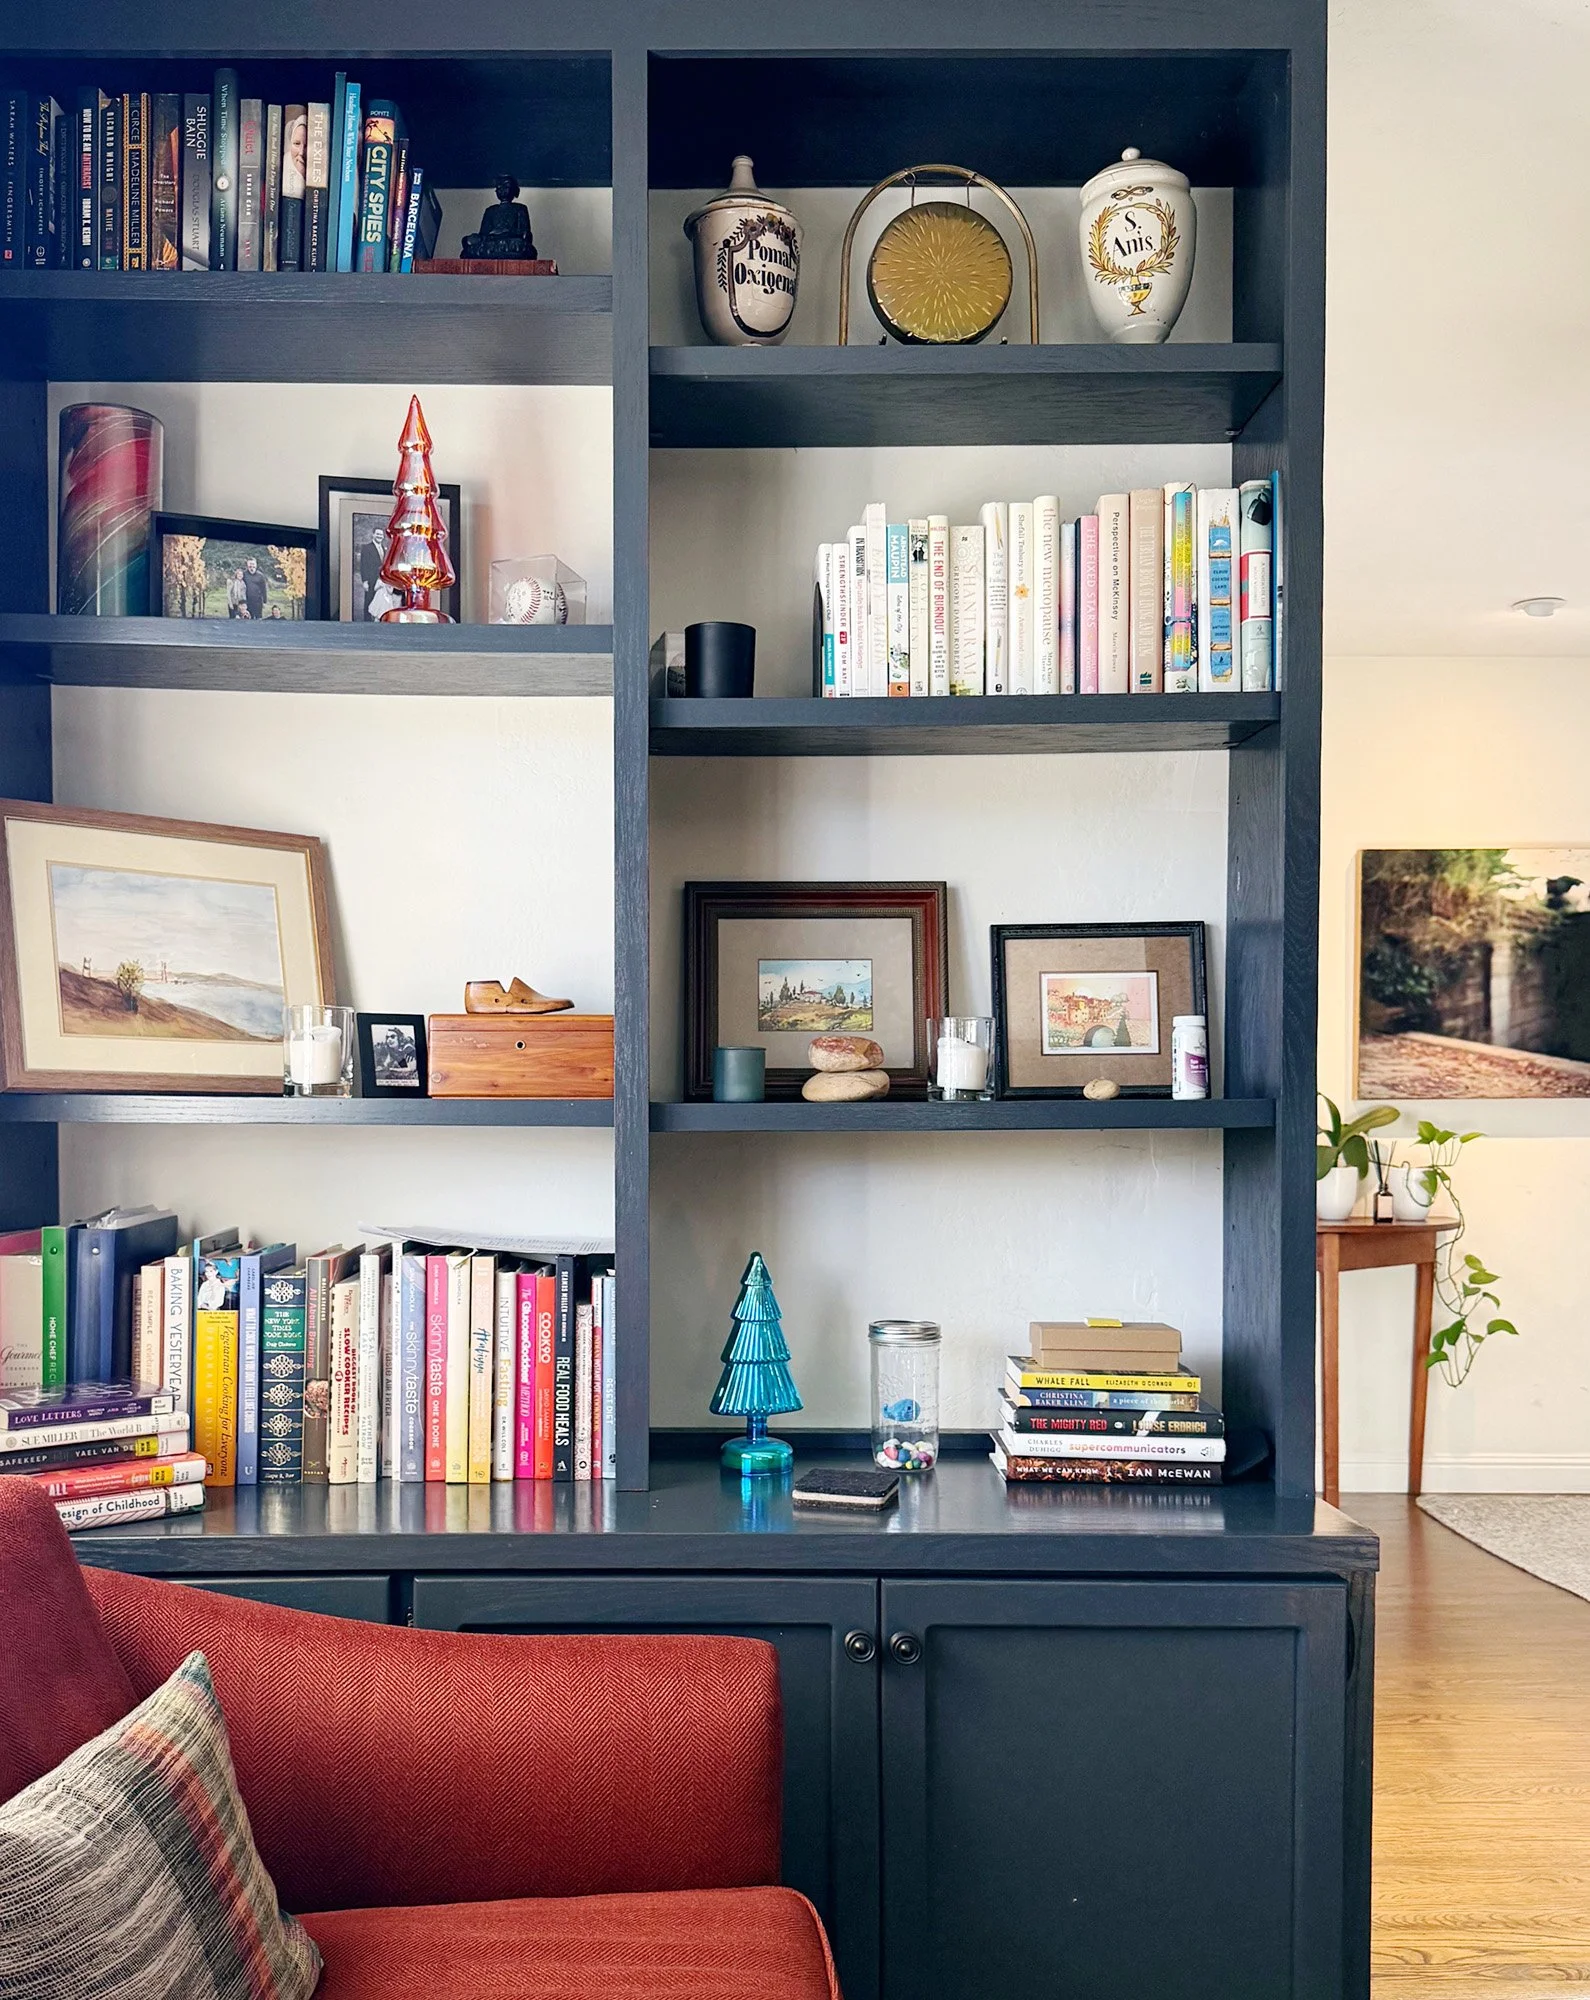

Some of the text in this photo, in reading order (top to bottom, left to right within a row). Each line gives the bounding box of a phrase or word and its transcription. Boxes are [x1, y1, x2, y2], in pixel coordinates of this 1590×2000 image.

[83, 108, 92, 124] HOW
[186, 118, 196, 148] BAIN
[196, 106, 207, 160] SHUGGIE
[218, 84, 229, 166] When Time Stopped
[244, 120, 258, 154] Quiet
[83, 142, 92, 152] AN
[105, 111, 114, 182] RICHARD WRIGHT
[312, 112, 323, 183] THE EXILES
[82, 153, 92, 189] ANTIRACIST
[131, 109, 140, 245] CIRCE MADELINE MILLER
[369, 146, 388, 190] CITY
[6, 181, 14, 242] FINGERSMITH
[82, 198, 91, 218] IBRAM
[105, 208, 113, 232] NATIVE
[192, 174, 200, 251] DOUGLAS STUART
[366, 191, 385, 244] SPIES
[402, 193, 421, 260] BARCELONA
[82, 227, 91, 246] KENDI
[1113, 232, 1157, 258] Anis.
[890, 535, 900, 579] MAUPIN
[900, 535, 908, 578] ARMISTEAD
[933, 541, 944, 557] THE
[1016, 514, 1026, 568] Shefali Tsabary
[1111, 512, 1120, 562] Perspective
[855, 545, 865, 576] TRANSITION
[934, 560, 944, 577] END
[1040, 508, 1056, 645] the new menopause
[1087, 528, 1096, 628] THE FIXED STARS
[839, 555, 847, 627] STRENGTHSFINDER
[934, 580, 945, 591] OF
[1111, 579, 1120, 621] McKinsey
[934, 595, 945, 636] BURNOUT
[963, 566, 977, 675] SHANTARAM
[170, 1268, 183, 1316] BAKING
[49, 1316, 57, 1361] HOME CHEF
[306, 1287, 318, 1369] All About Braising
[367, 1327, 375, 1344] IT'S
[541, 1311, 552, 1364] COOK90
[367, 1345, 375, 1360] ALL
[428, 1313, 445, 1396] skinnytaste
[473, 1327, 491, 1375] Arabiyya
[497, 1296, 511, 1407] INTUITIVE Fasting
[205, 1326, 213, 1457] DEBORAH MADISON
[342, 1327, 351, 1436] SLOW COOKER RECIPES
[403, 1331, 420, 1414] skinnytaste
[1035, 1376, 1066, 1386] WHALE
[1069, 1378, 1090, 1386] FALL
[15, 1410, 82, 1425] LOVE LETTERS
[218, 1325, 235, 1477] Vegetarian Cooking for Everyone
[555, 1356, 570, 1446] REAL FOOD HEALS
[1039, 1391, 1084, 1399] CHRISTINA
[1119, 1396, 1137, 1406] piece
[22, 1431, 78, 1447] SUE MILLER
[90, 1428, 107, 1438] The
[108, 1425, 134, 1436] World
[1027, 1438, 1063, 1446] CHARLES
[1030, 1417, 1207, 1433] THE MIGHTY RED LOUISE ERDRICH
[0, 1454, 48, 1467] SAFEKEEP
[75, 1445, 119, 1458] YAEL VAN
[1068, 1442, 1187, 1456] supercommunicators
[48, 1482, 68, 1497] ALL
[1127, 1467, 1153, 1477] IAN
[1158, 1469, 1211, 1479] McEWAN
[59, 1507, 89, 1521] esign
[92, 1503, 103, 1514] of
[106, 1494, 160, 1512] Childhood
